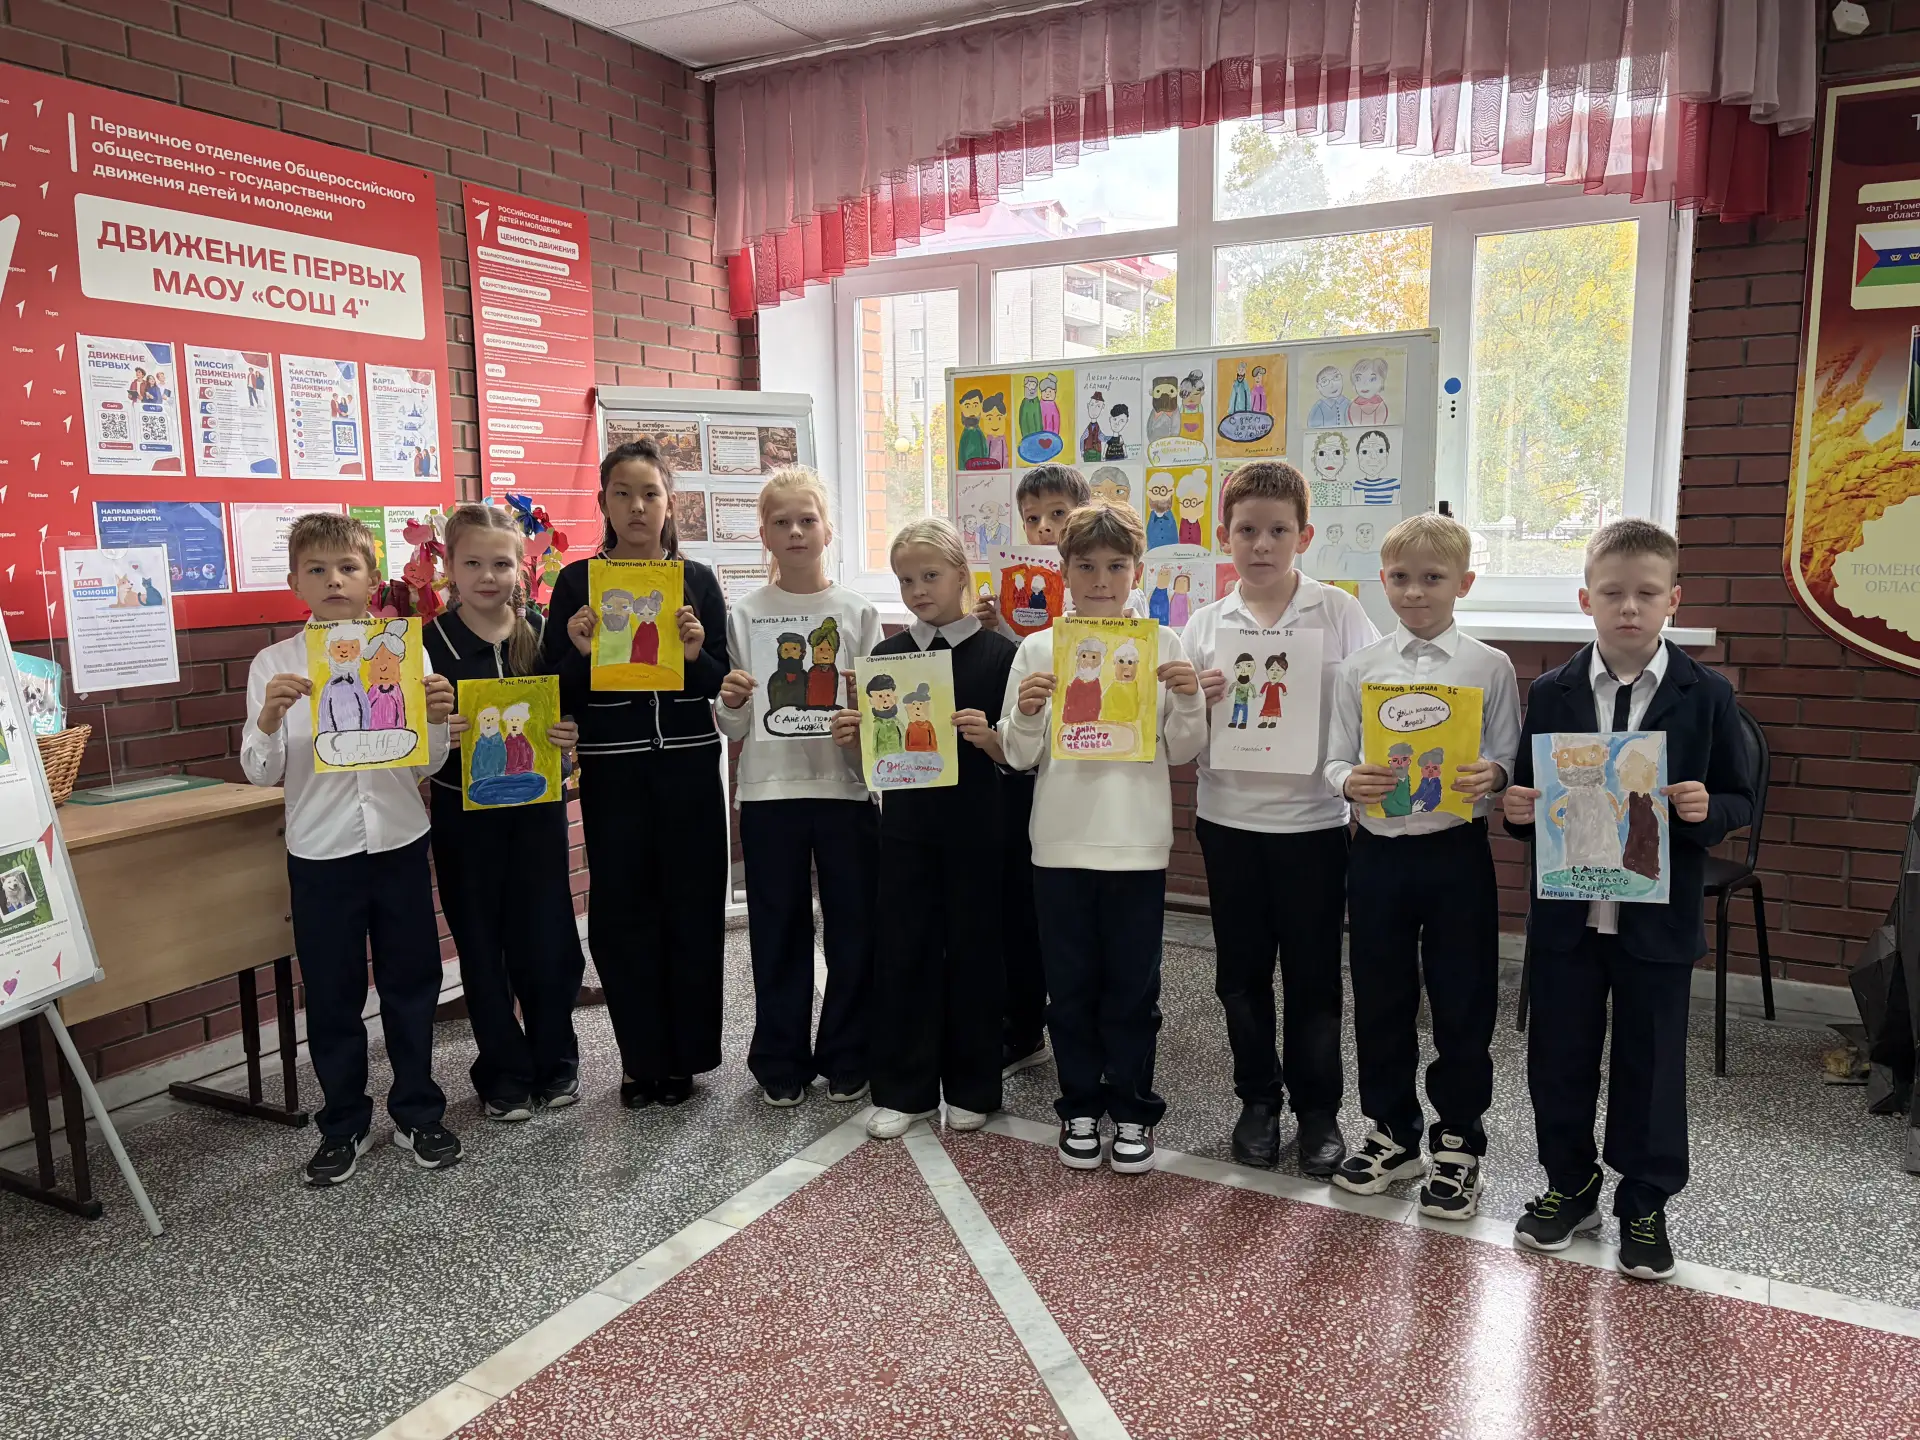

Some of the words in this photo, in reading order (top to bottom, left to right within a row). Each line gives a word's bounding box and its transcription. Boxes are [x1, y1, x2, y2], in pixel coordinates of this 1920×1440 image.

[90, 115, 192, 151] Первичное
[195, 142, 282, 172] отделение
[284, 160, 416, 203] Общероссийского
[91, 141, 215, 177] общественно
[229, 170, 366, 210] государственного
[92, 163, 185, 191] движения
[188, 182, 237, 202] детей
[240, 193, 251, 204] и
[254, 196, 333, 221] молодежи
[498, 205, 540, 221] РОССИЙСКОЕ
[540, 216, 573, 229] ДВИЖЕНИЕ
[498, 215, 520, 225] ДЕТЕЙ
[525, 221, 561, 235] МОЛОДЕЖИ
[500, 232, 538, 247] ЦЕННОСТЬ
[538, 241, 576, 255] ДВИЖЕНИЯ
[97, 220, 287, 274] ДВИЖЕНИЕ
[293, 253, 407, 293] ПЕРВЫХ
[152, 267, 245, 302] МАОУ
[252, 285, 336, 316] «СОШ
[87, 350, 146, 362] ДВИЖЕНИЕ
[88, 360, 131, 370] ПЕРВЫХ
[194, 360, 234, 370] МИССИЯ
[195, 369, 246, 380] ДВИЖЕНИЯ
[195, 378, 233, 387] ПЕРВЫХ
[290, 376, 340, 386] УЧАСТНИКОМ
[372, 378, 396, 386] КАРТА
[290, 384, 333, 392] ДВИЖЕНИЯ
[373, 385, 430, 394] ВОЗМОЖНОСТЕЙ
[291, 391, 322, 399] ПЕРВЫХ
[76, 588, 114, 596] ПОМОЩИ
